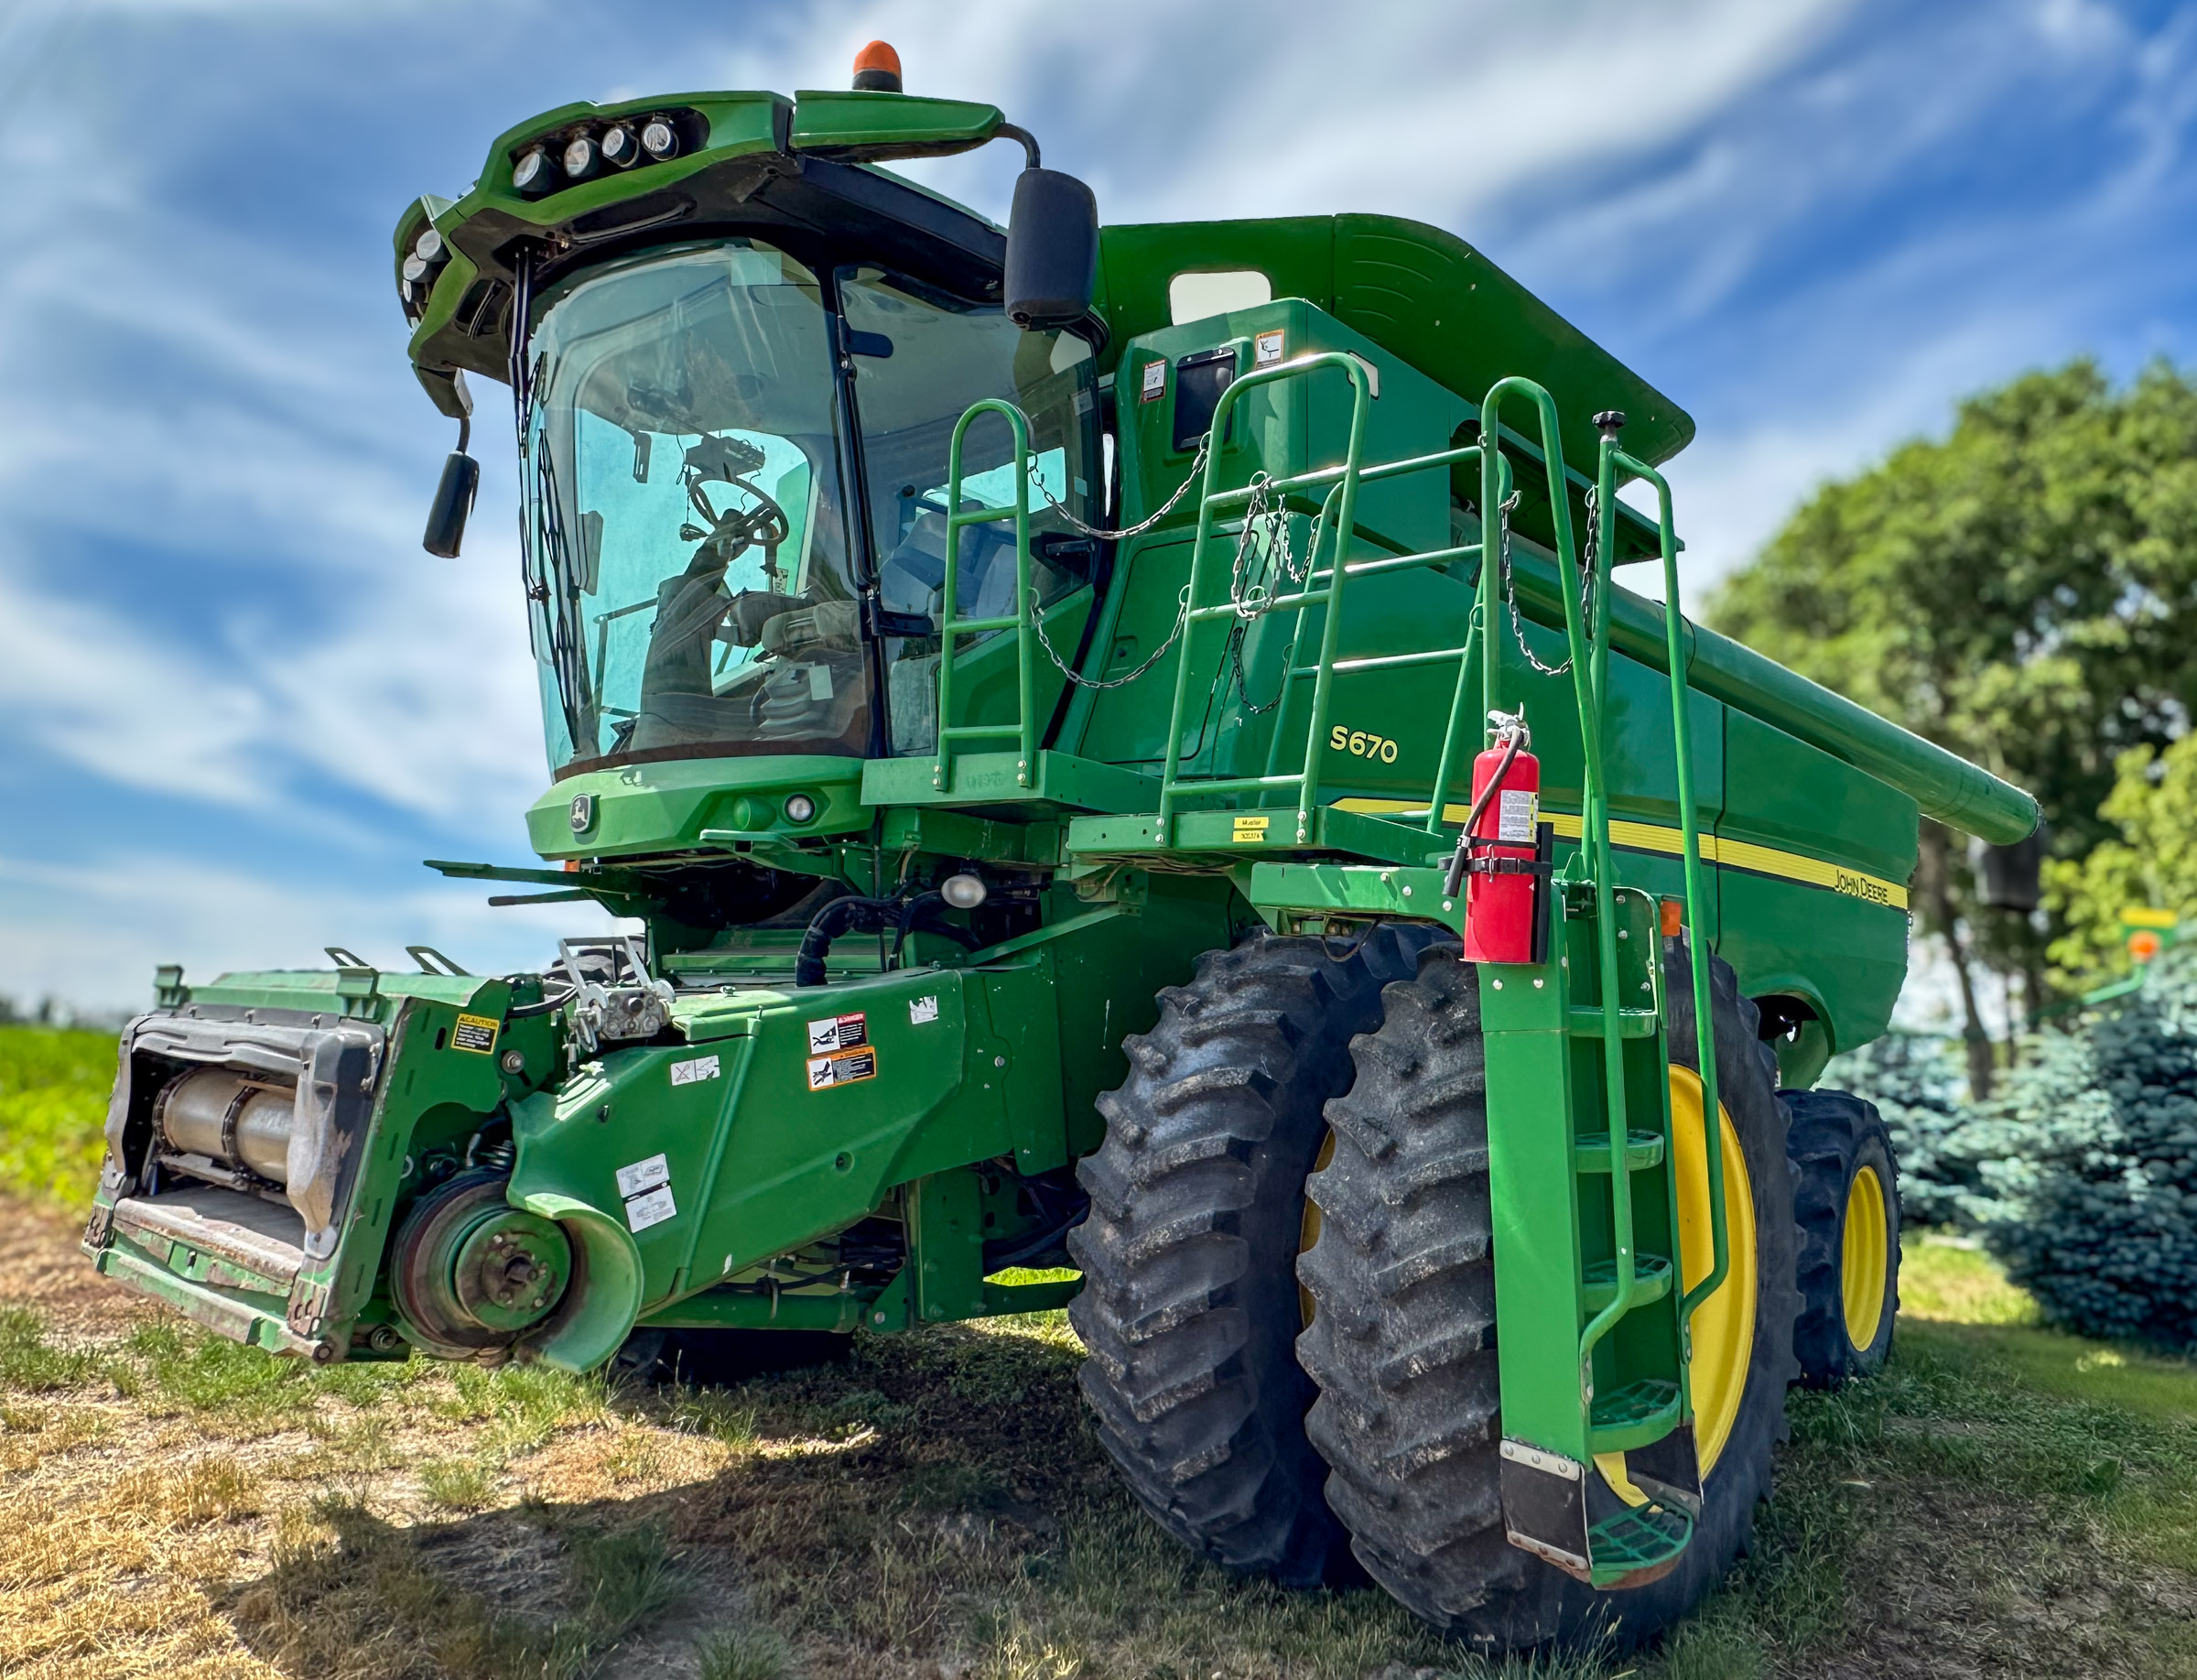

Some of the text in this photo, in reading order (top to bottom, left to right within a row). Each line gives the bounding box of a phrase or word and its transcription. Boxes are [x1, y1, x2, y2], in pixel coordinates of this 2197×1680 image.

[1330, 725, 1398, 764] S670
[1834, 869, 1889, 904] JOHN DEERE
